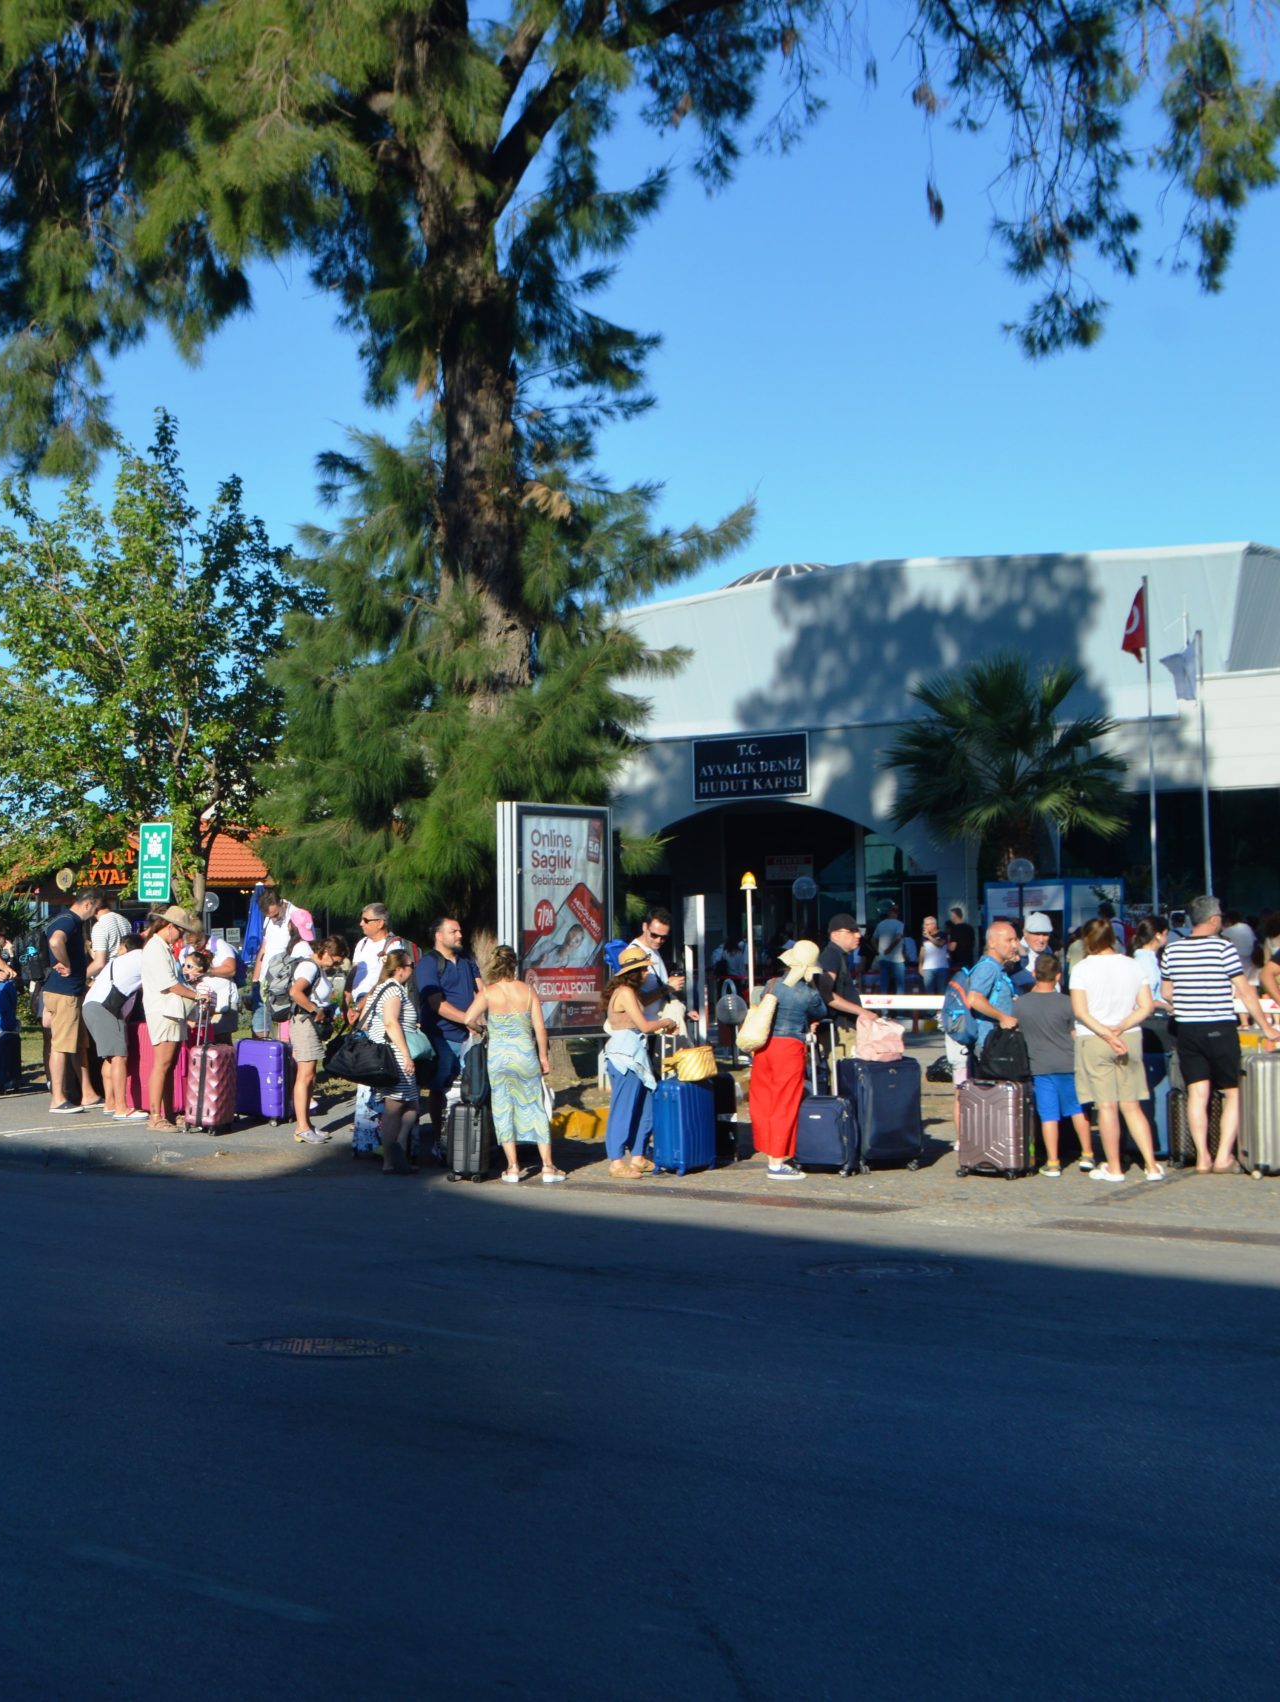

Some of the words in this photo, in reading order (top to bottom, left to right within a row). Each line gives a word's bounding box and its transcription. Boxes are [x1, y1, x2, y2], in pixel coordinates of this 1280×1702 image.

[737, 744, 761, 756] T.C.
[700, 762, 756, 777] AYVALIK
[759, 757, 802, 773] DENİZ
[700, 780, 750, 793] HUDUT
[753, 776, 803, 790] KAPISI
[531, 829, 572, 848] Online
[531, 850, 572, 873] Sağlık
[531, 874, 572, 886] Cebinizde!
[537, 904, 554, 931] 7/24
